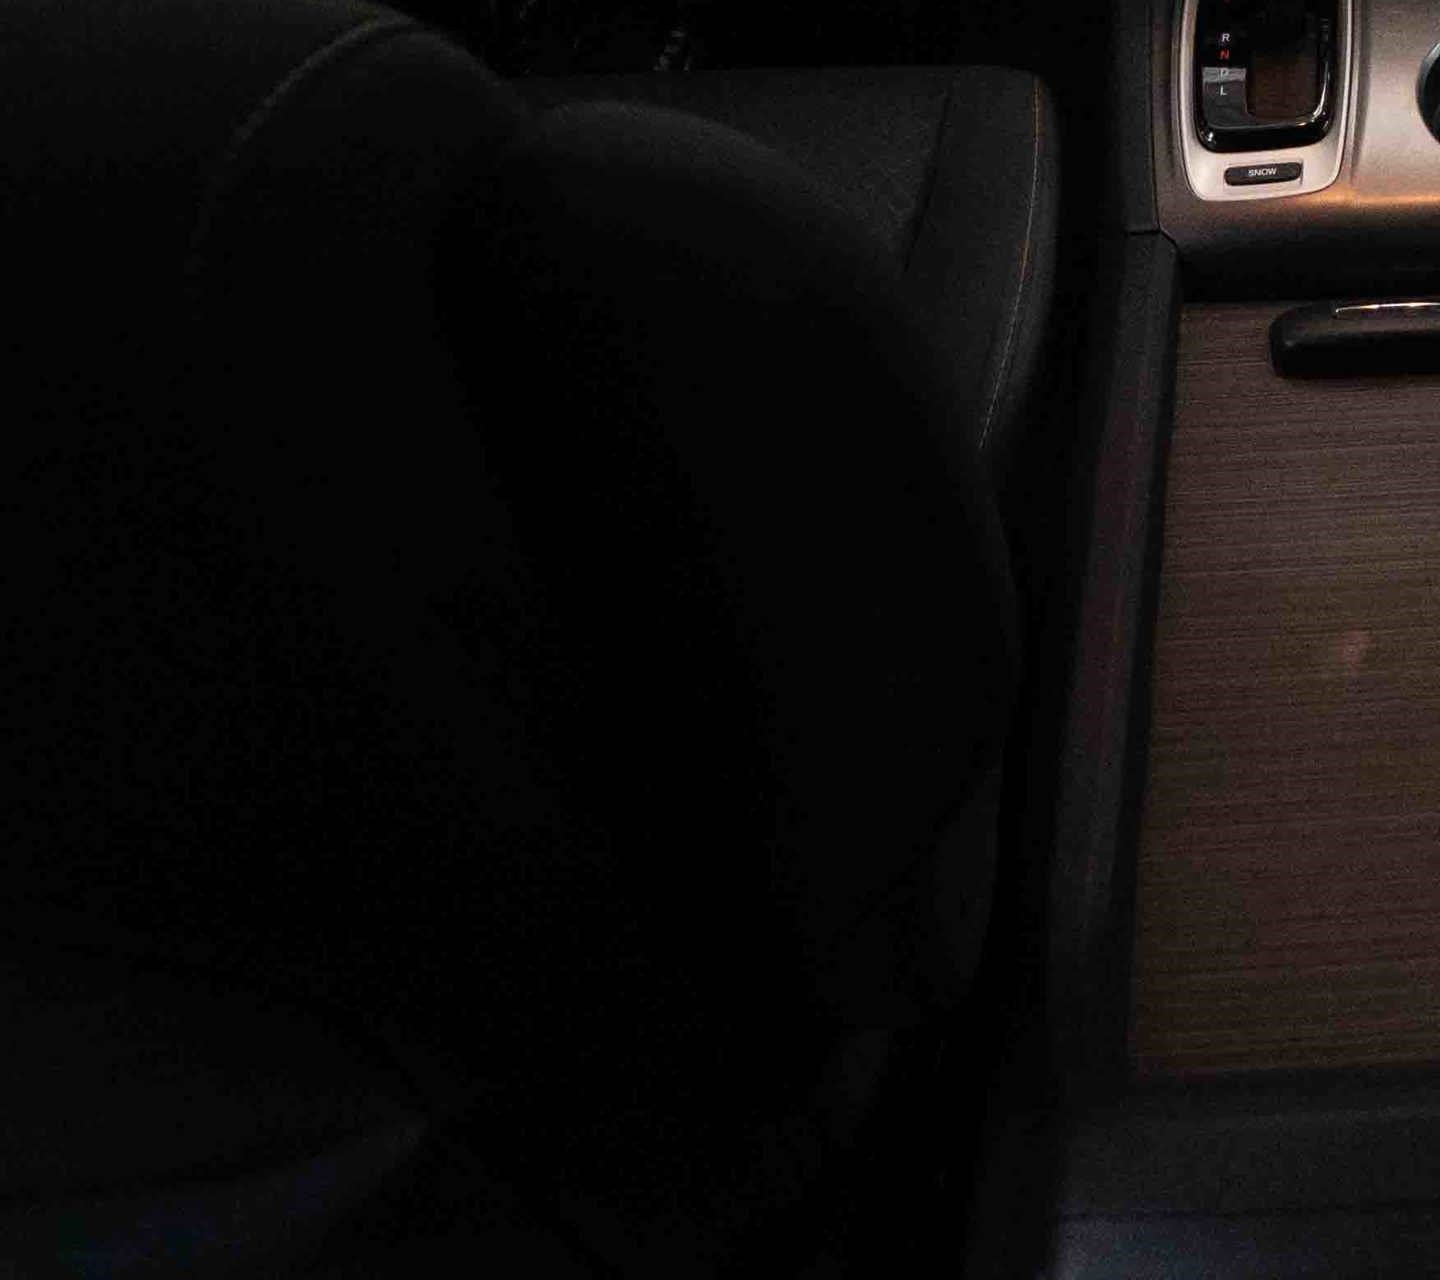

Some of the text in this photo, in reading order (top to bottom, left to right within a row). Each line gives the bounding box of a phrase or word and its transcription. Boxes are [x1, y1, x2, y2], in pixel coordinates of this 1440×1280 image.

[1222, 33, 1231, 42] R
[1220, 48, 1230, 59] N
[1220, 86, 1227, 96] L
[1248, 167, 1277, 177] SNOW
